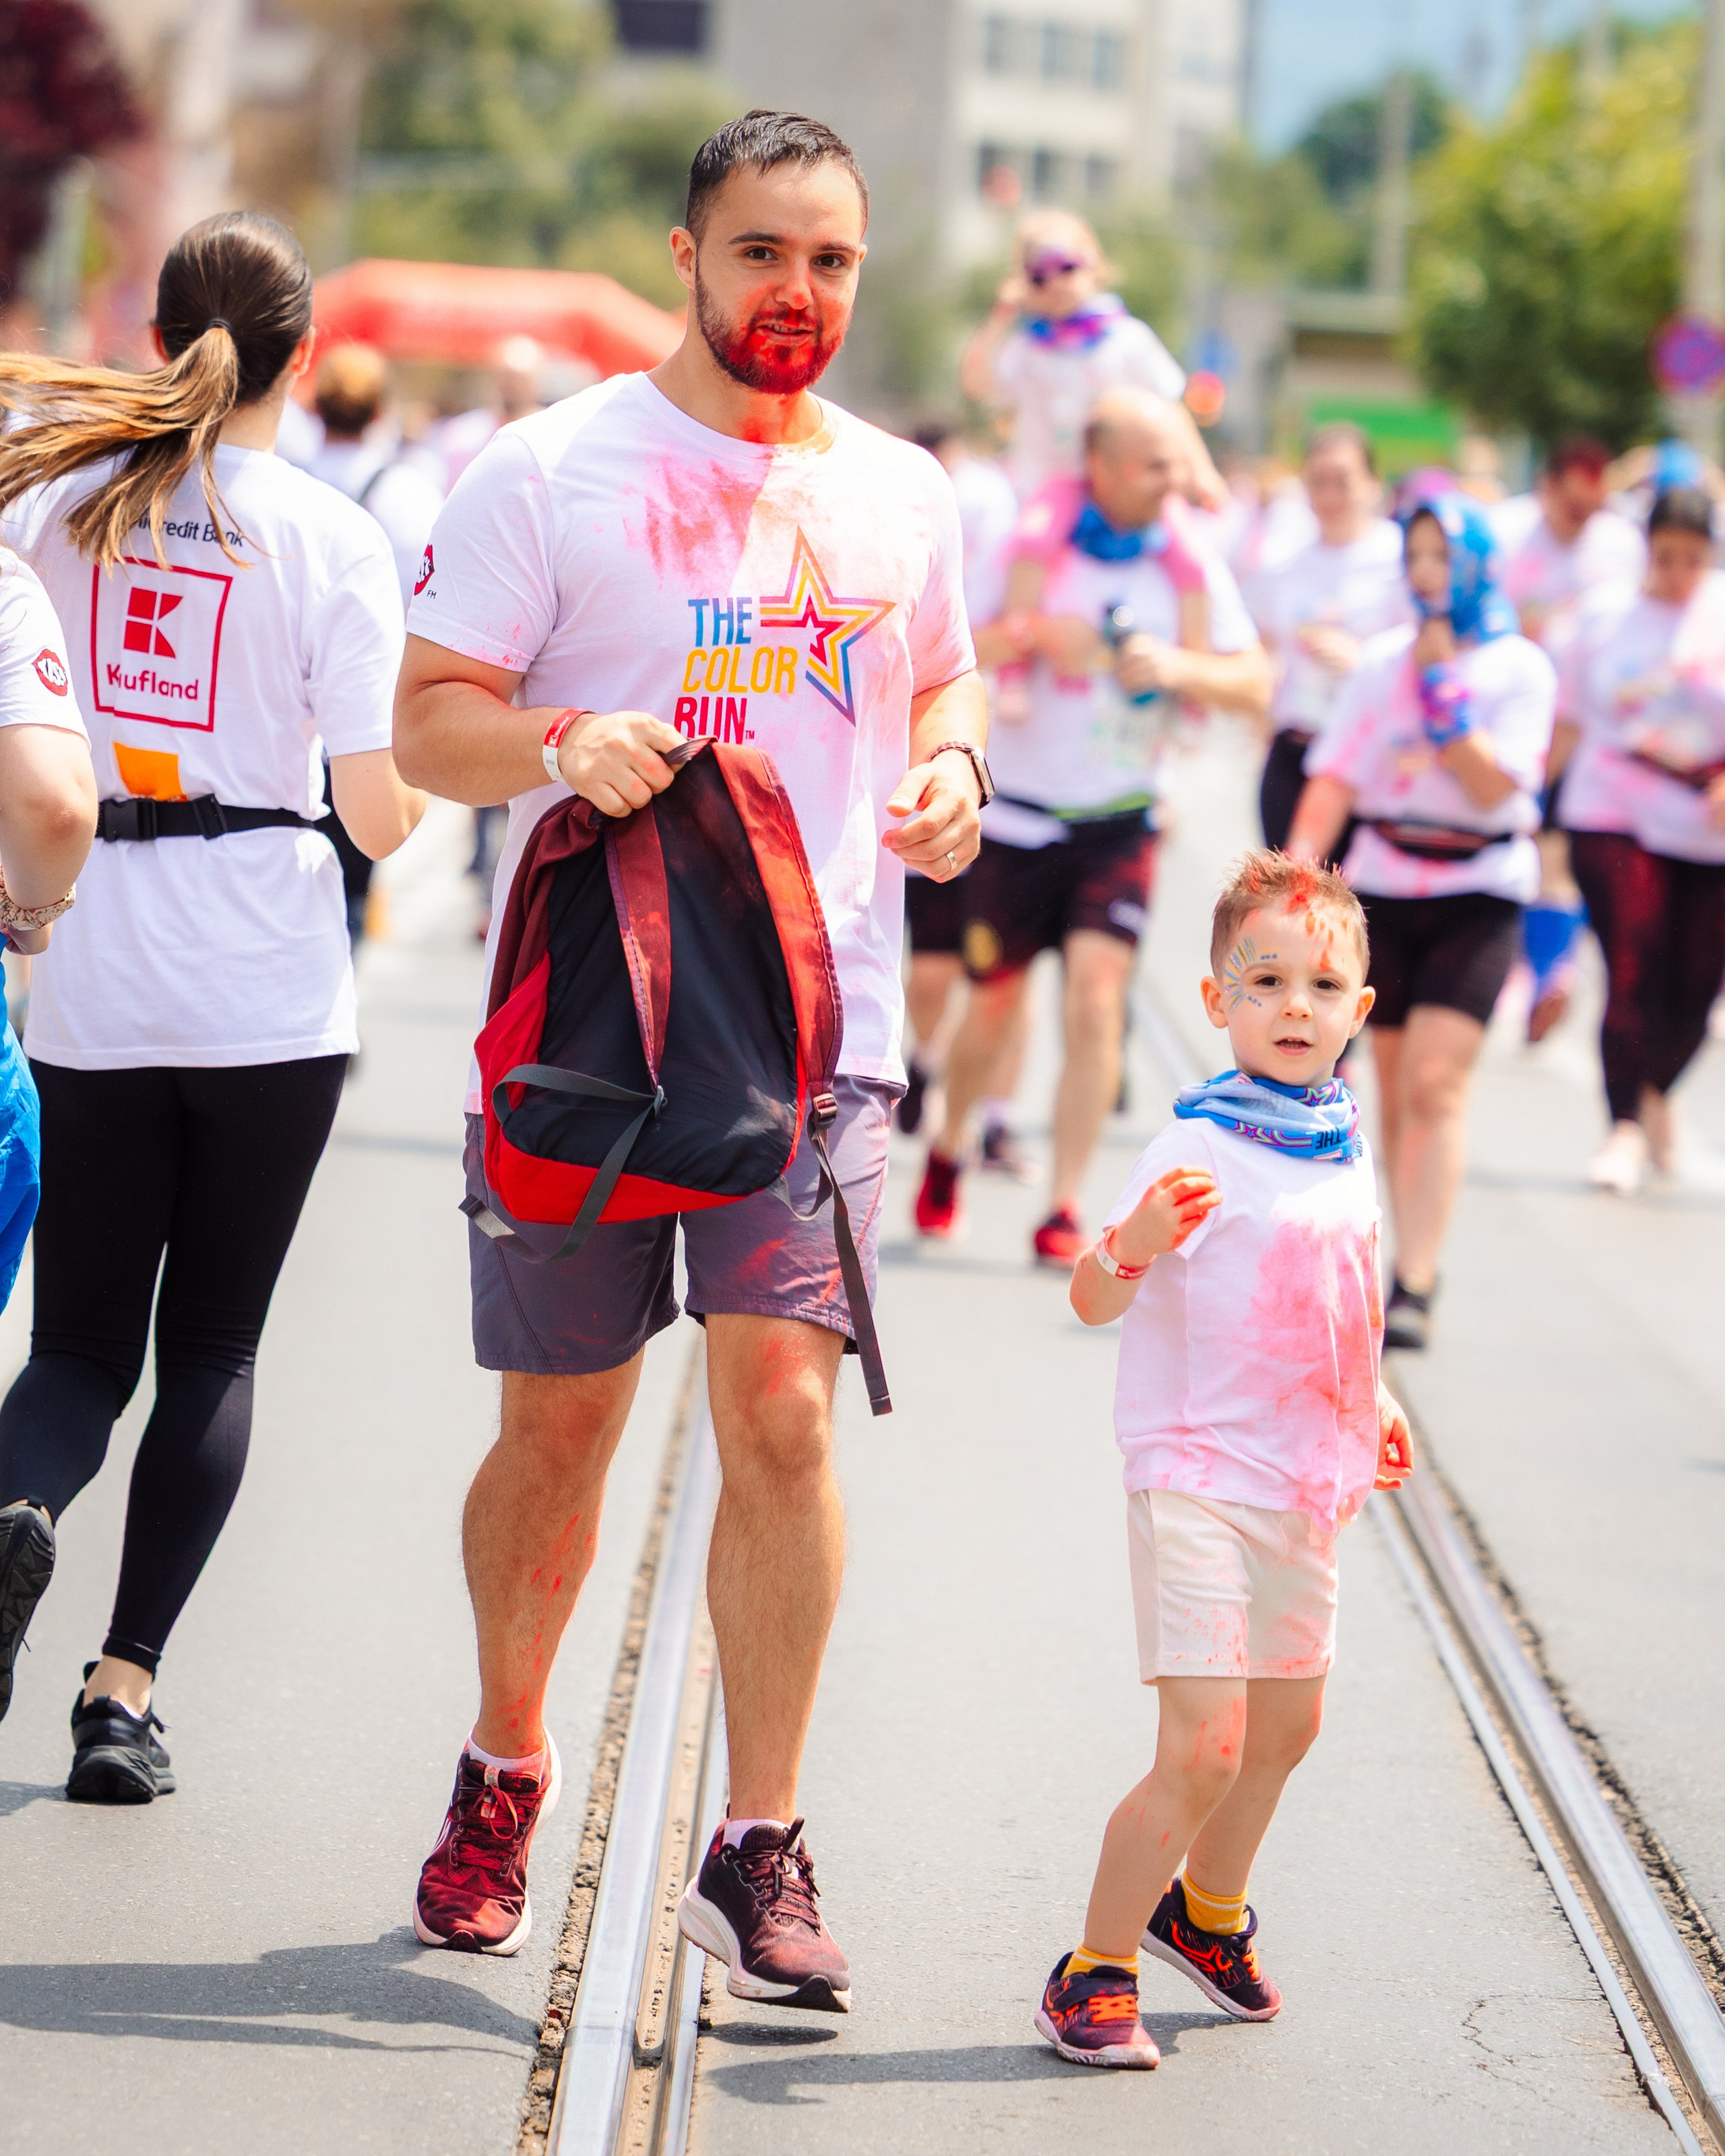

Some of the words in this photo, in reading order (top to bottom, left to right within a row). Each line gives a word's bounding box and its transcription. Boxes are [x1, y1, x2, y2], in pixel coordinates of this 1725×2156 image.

[203, 524, 243, 547] Bnk
[687, 597, 752, 647] THE
[106, 664, 199, 701] Kufland
[682, 646, 798, 695] COLOR
[674, 696, 747, 745] RUN
